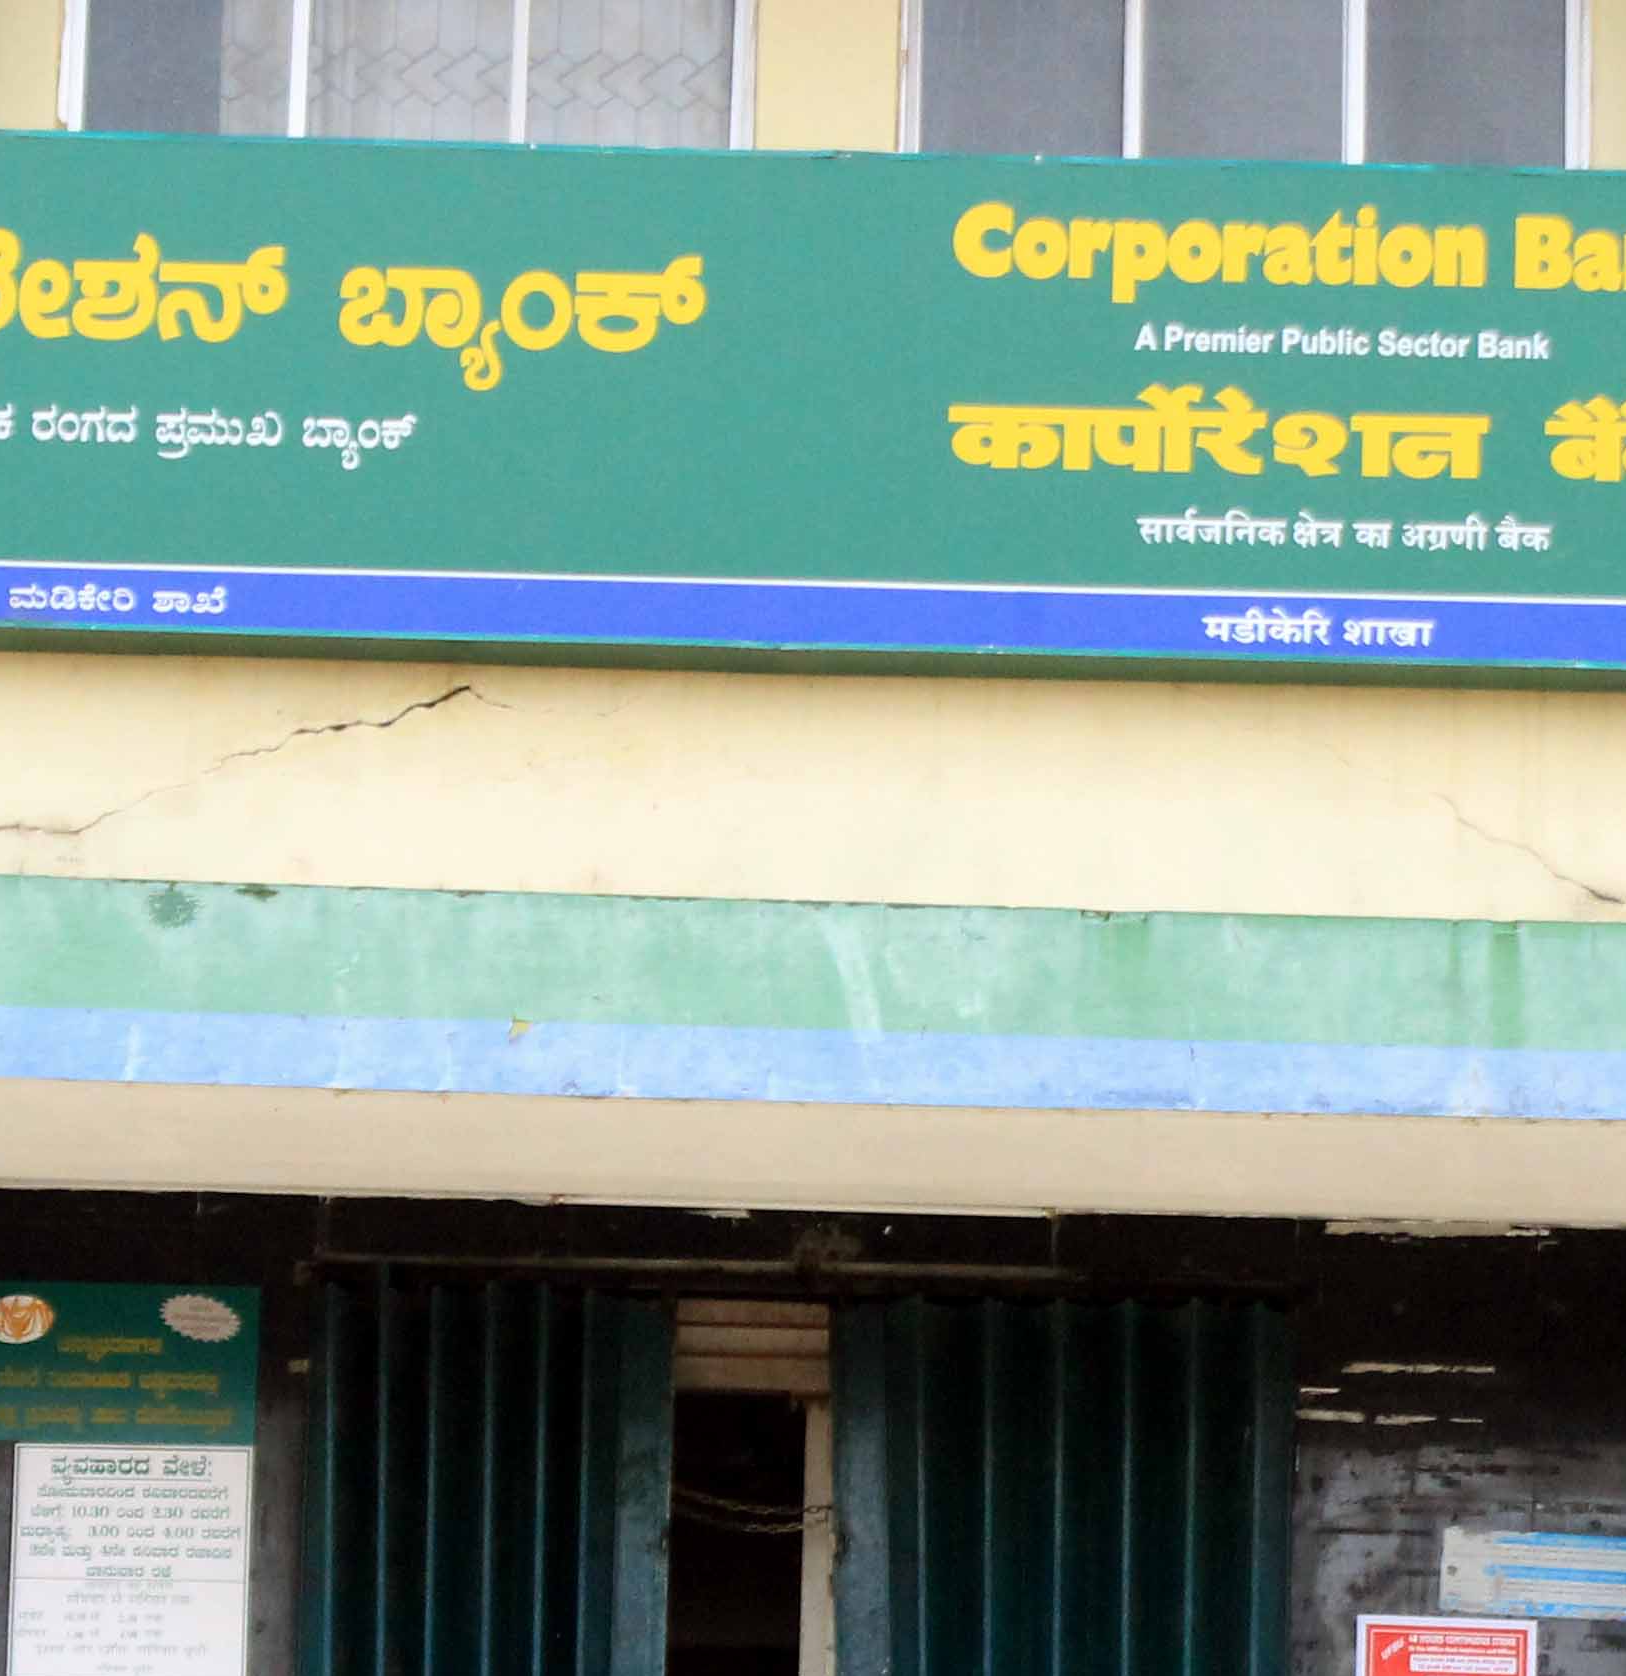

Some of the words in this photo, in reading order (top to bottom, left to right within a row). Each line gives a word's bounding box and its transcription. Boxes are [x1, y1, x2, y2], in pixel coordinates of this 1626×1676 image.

[952, 200, 1489, 305] Corporation
[338, 254, 708, 392] ಬ್ಯಾಂಕ್
[1134, 322, 1159, 352] A
[1163, 322, 1275, 355] Premier
[1281, 325, 1371, 357] Public
[1376, 327, 1472, 360] Sector
[1476, 330, 1551, 361] Bank
[31, 404, 140, 444] ರಂಗದ
[155, 407, 284, 460] ಪ್ರಮುಖ
[301, 412, 418, 471] ಬ್ಯಾಂಕ್
[1136, 507, 1288, 547] सार्वजनिक
[1292, 510, 1344, 549] क्षेत्र
[1351, 520, 1394, 550] का
[1400, 513, 1490, 552] अग्रणी
[8, 582, 136, 613] ಮಡಿಕೇರಿ
[151, 584, 228, 615] ಶಾಖೆ
[1342, 617, 1436, 648] शाखा
